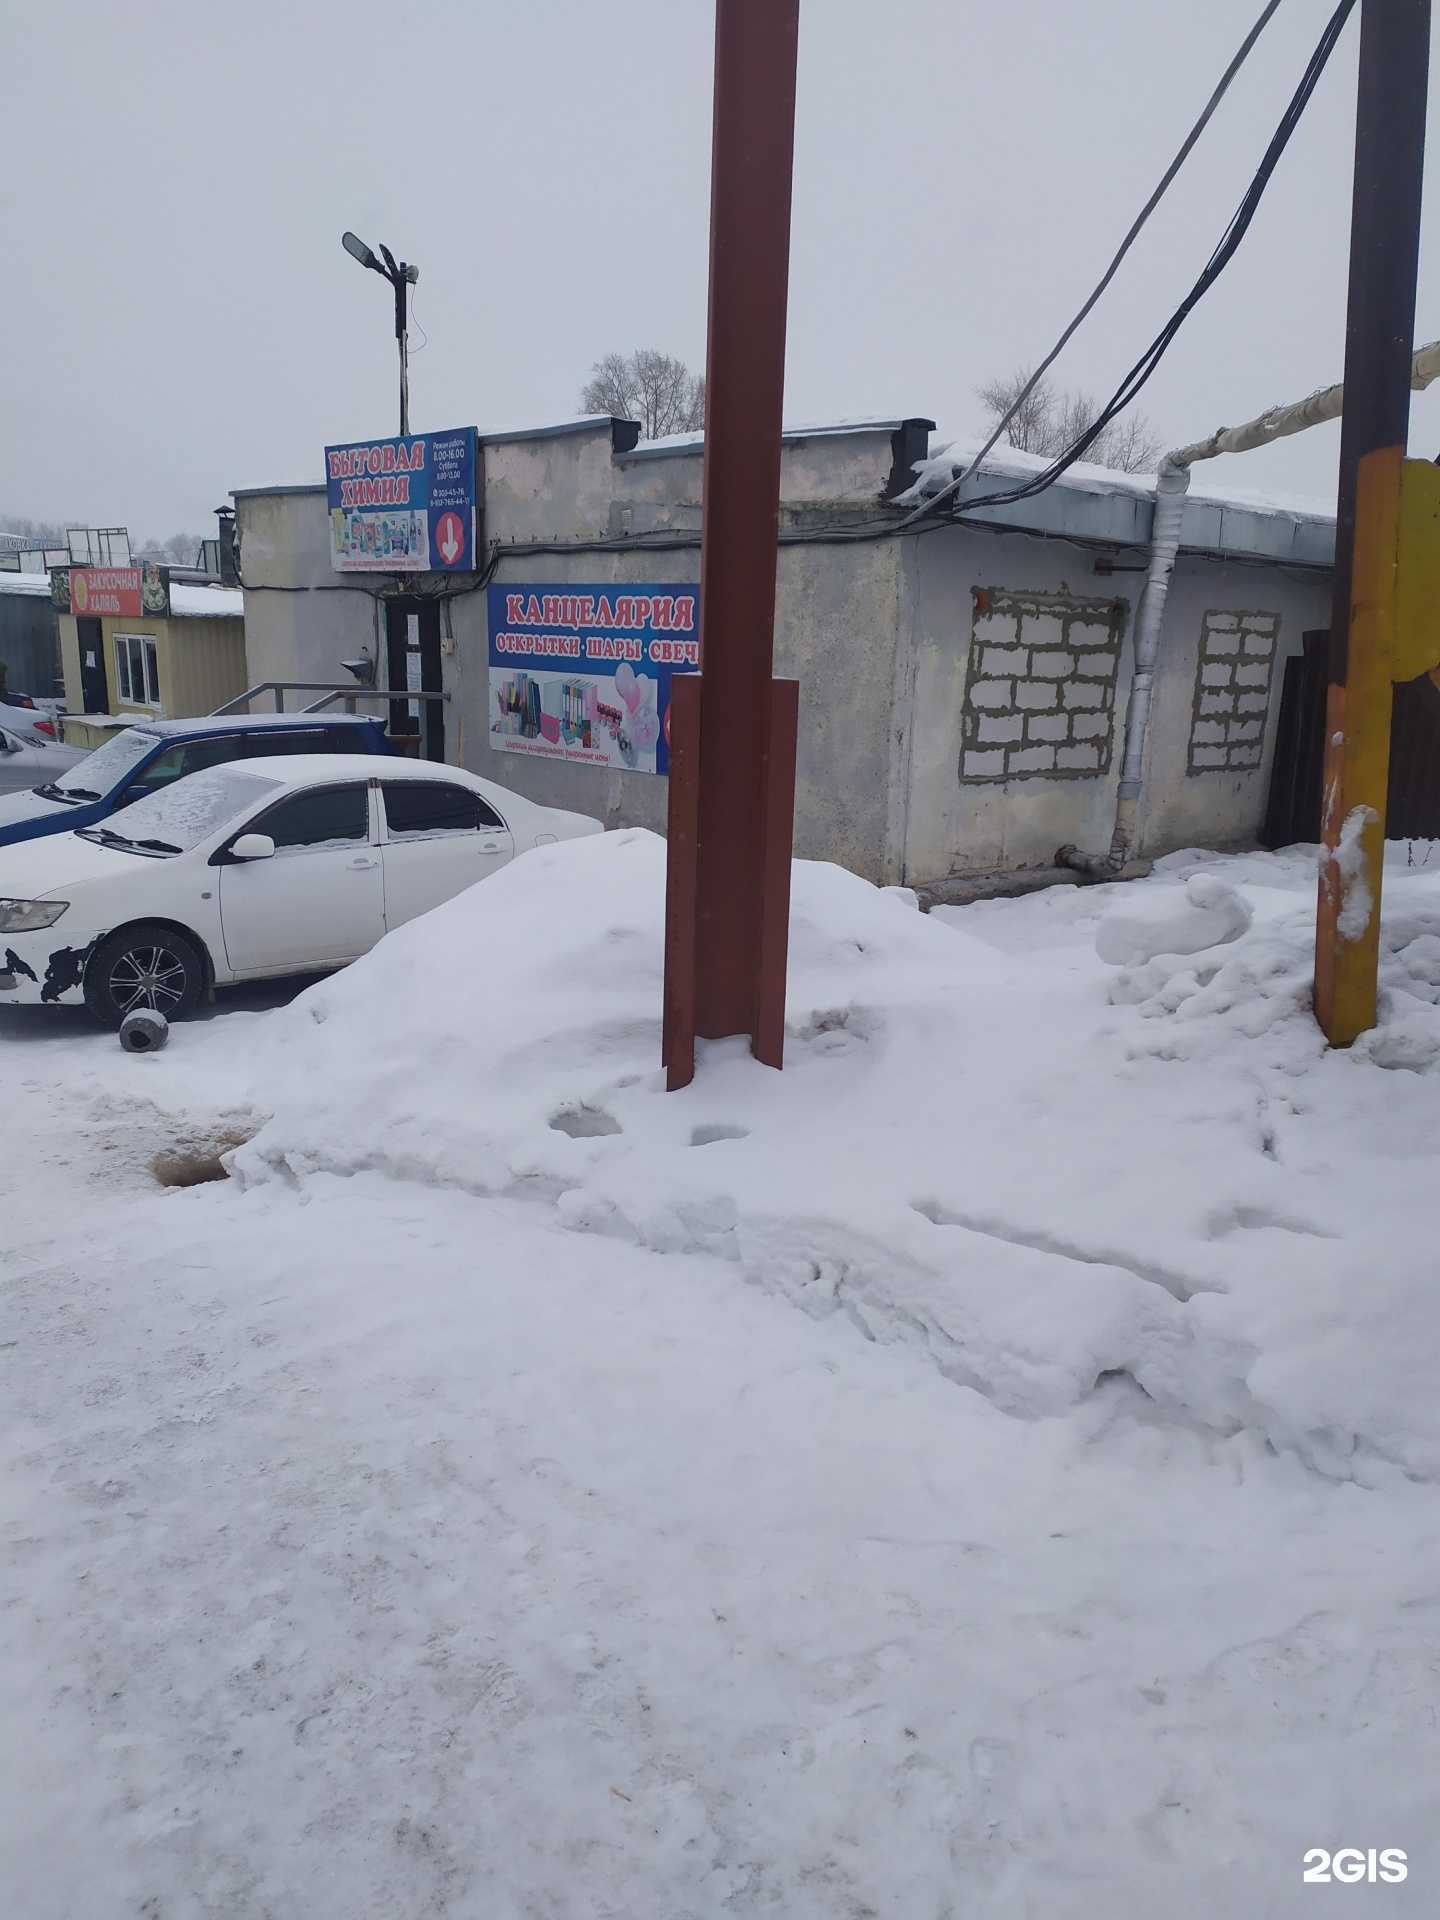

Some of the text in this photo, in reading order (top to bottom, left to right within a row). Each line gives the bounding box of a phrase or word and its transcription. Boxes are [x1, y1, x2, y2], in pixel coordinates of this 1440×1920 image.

[328, 441, 425, 479] БЫТОВАЯ
[341, 475, 410, 508] ХИМИЯ
[89, 573, 138, 590] ЗАКУСОЧНАЯ
[506, 594, 695, 631] КАНЦЕЛЯРИЯ
[496, 633, 700, 664] ОТКРЫТКИ ШАРЫ СВЕЧ
